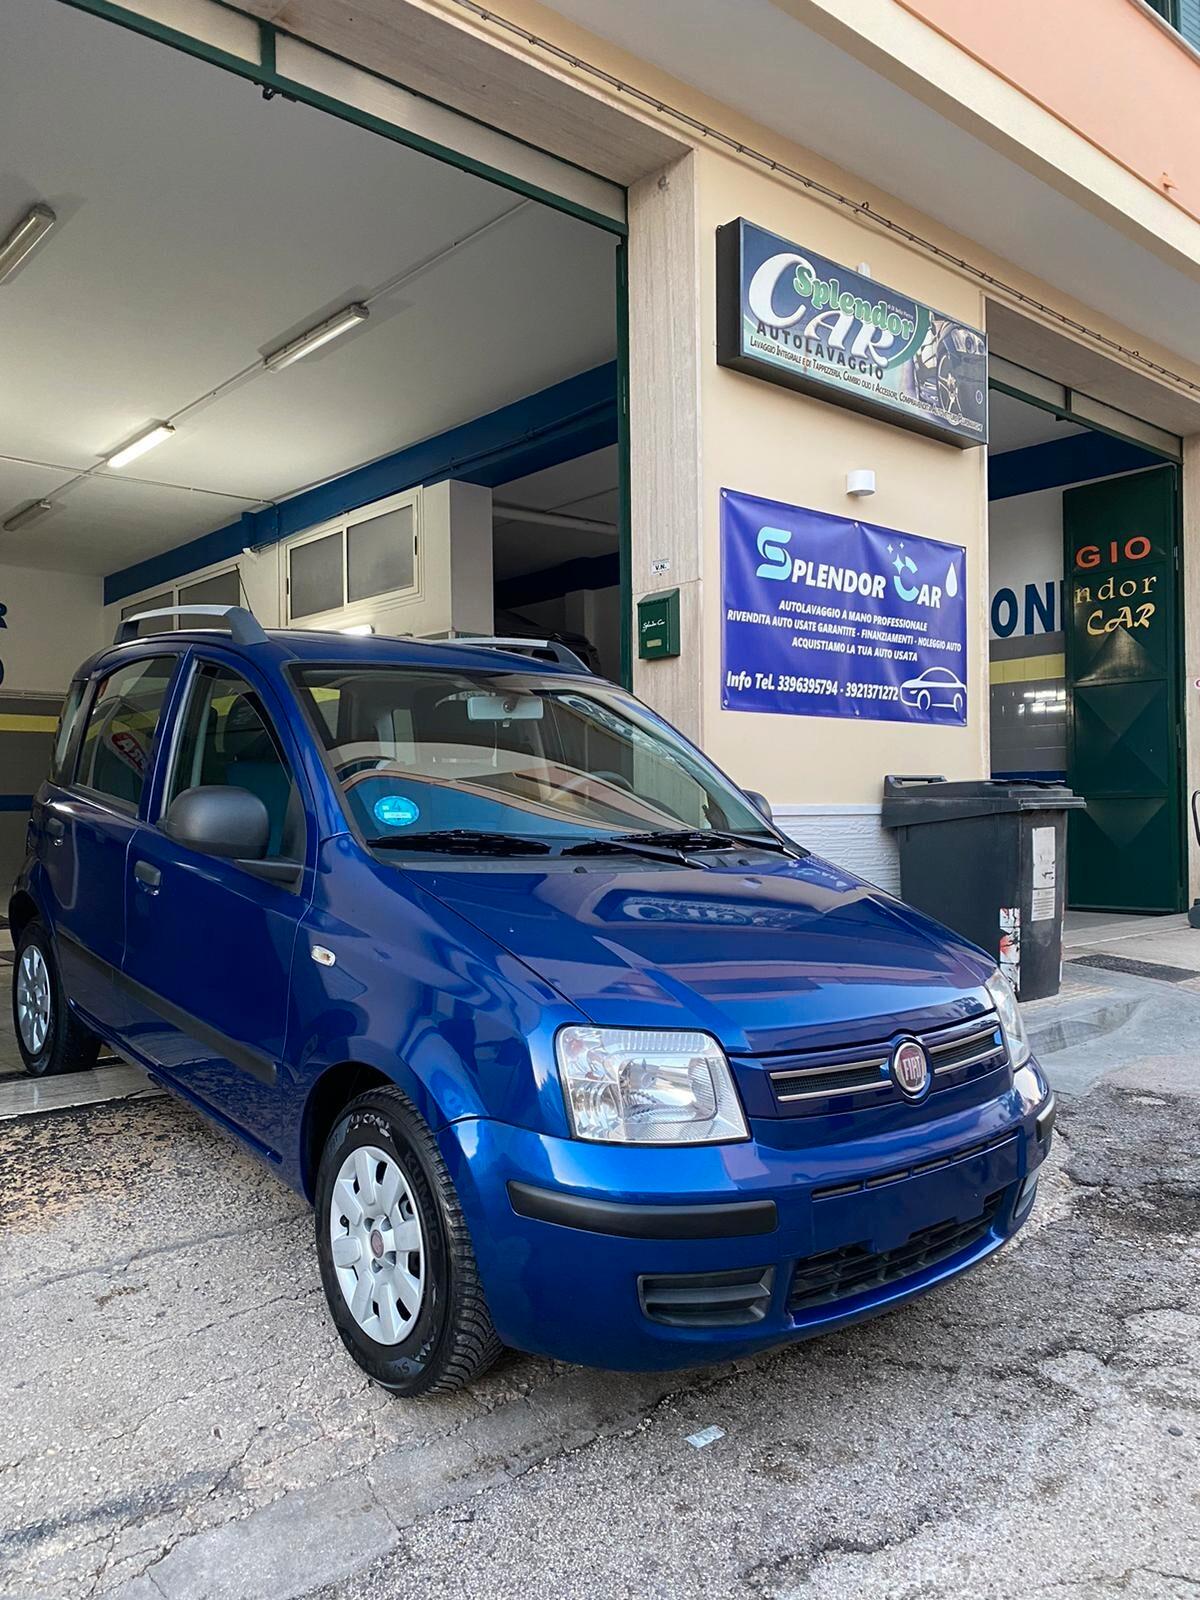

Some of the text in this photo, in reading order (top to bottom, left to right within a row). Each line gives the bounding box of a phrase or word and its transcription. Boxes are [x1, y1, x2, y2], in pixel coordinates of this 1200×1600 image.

[793, 264, 914, 340] Splendor
[757, 322, 883, 380] AUTOLAVAGGIO
[757, 526, 887, 598] SPLENDOR
[1075, 576, 1158, 604] ndor
[727, 610, 771, 626] RIVENDITA
[771, 616, 793, 629] AUTO
[794, 619, 817, 632] USATE
[817, 623, 856, 637] GARANTITE
[861, 629, 913, 645] FINANZIAMENTI
[918, 637, 945, 650] NOLEGGIO
[946, 642, 962, 652] AUTO
[779, 600, 928, 632] AUTOLAVAGGIO A MANO PROFESSIONALE
[1086, 603, 1156, 636] CAR
[792, 637, 918, 662] ACQUISTIAMO LA TUA AUTO USATA
[726, 670, 752, 691] Info
[755, 673, 775, 690] Tel.
[777, 675, 839, 696] 3396395794
[845, 682, 899, 700] 3921371272
[902, 1056, 922, 1081] FIAT
